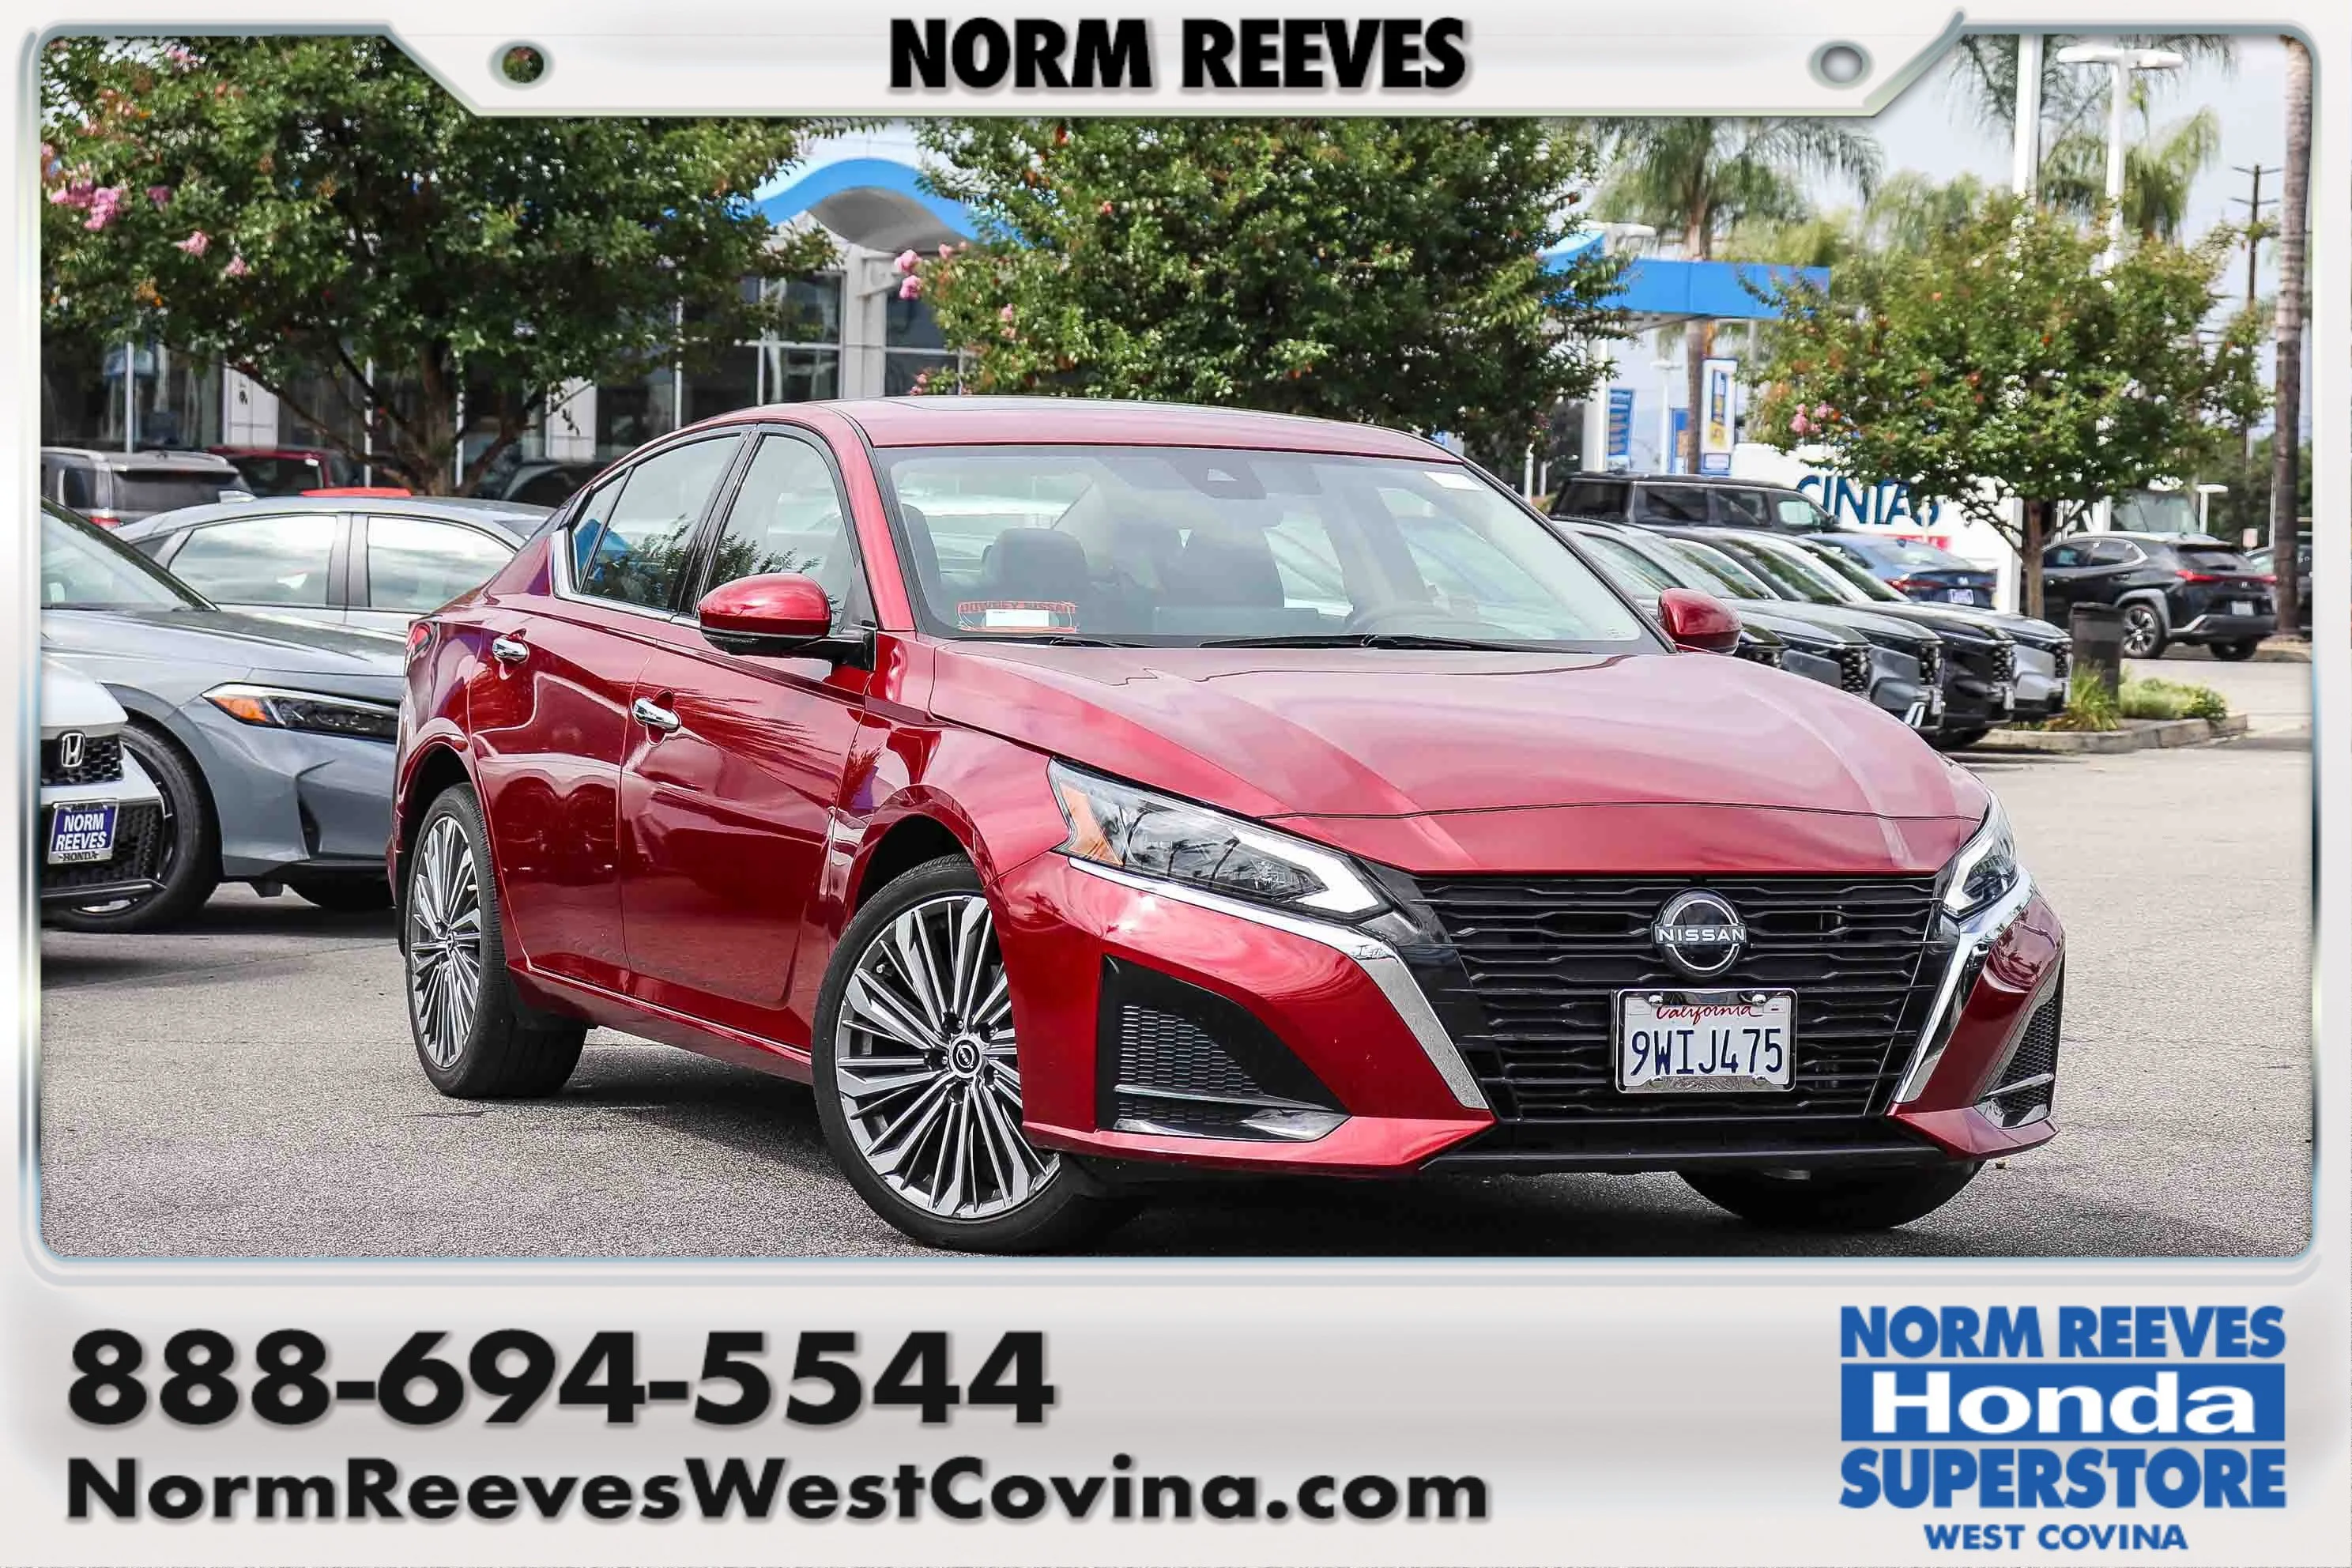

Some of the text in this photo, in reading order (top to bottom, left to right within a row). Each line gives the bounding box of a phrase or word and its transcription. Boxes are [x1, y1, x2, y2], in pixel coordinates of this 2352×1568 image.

[64, 813, 104, 832] NORM
[55, 831, 107, 850] REEVES
[59, 851, 100, 861] HONDA
[1658, 928, 1746, 943] NISSAN
[1657, 1004, 1762, 1025] California
[1630, 1027, 1784, 1076] 9WIJ475
